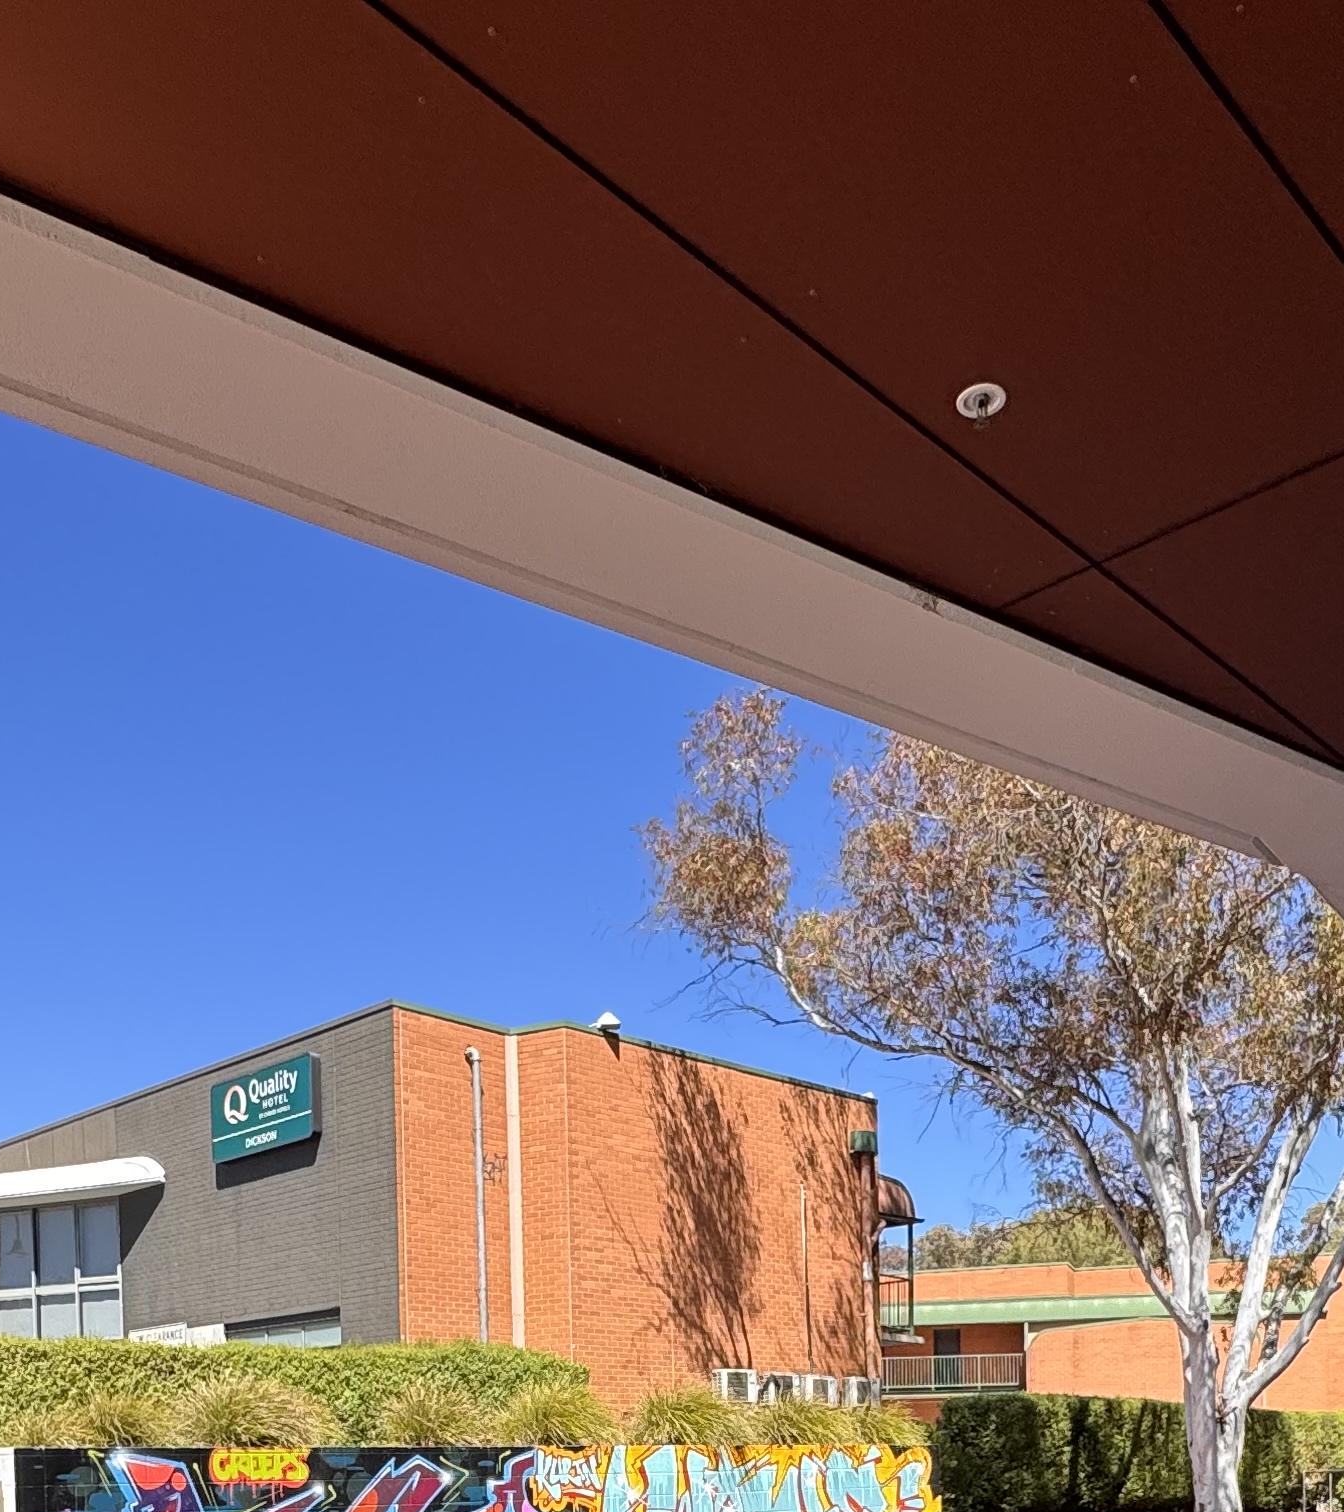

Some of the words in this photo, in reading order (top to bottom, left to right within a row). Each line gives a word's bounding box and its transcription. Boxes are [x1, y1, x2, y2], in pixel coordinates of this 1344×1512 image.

[248, 1069, 298, 1104] Quality
[262, 1092, 289, 1110] HOTEL
[245, 1129, 278, 1149] DICKSON
